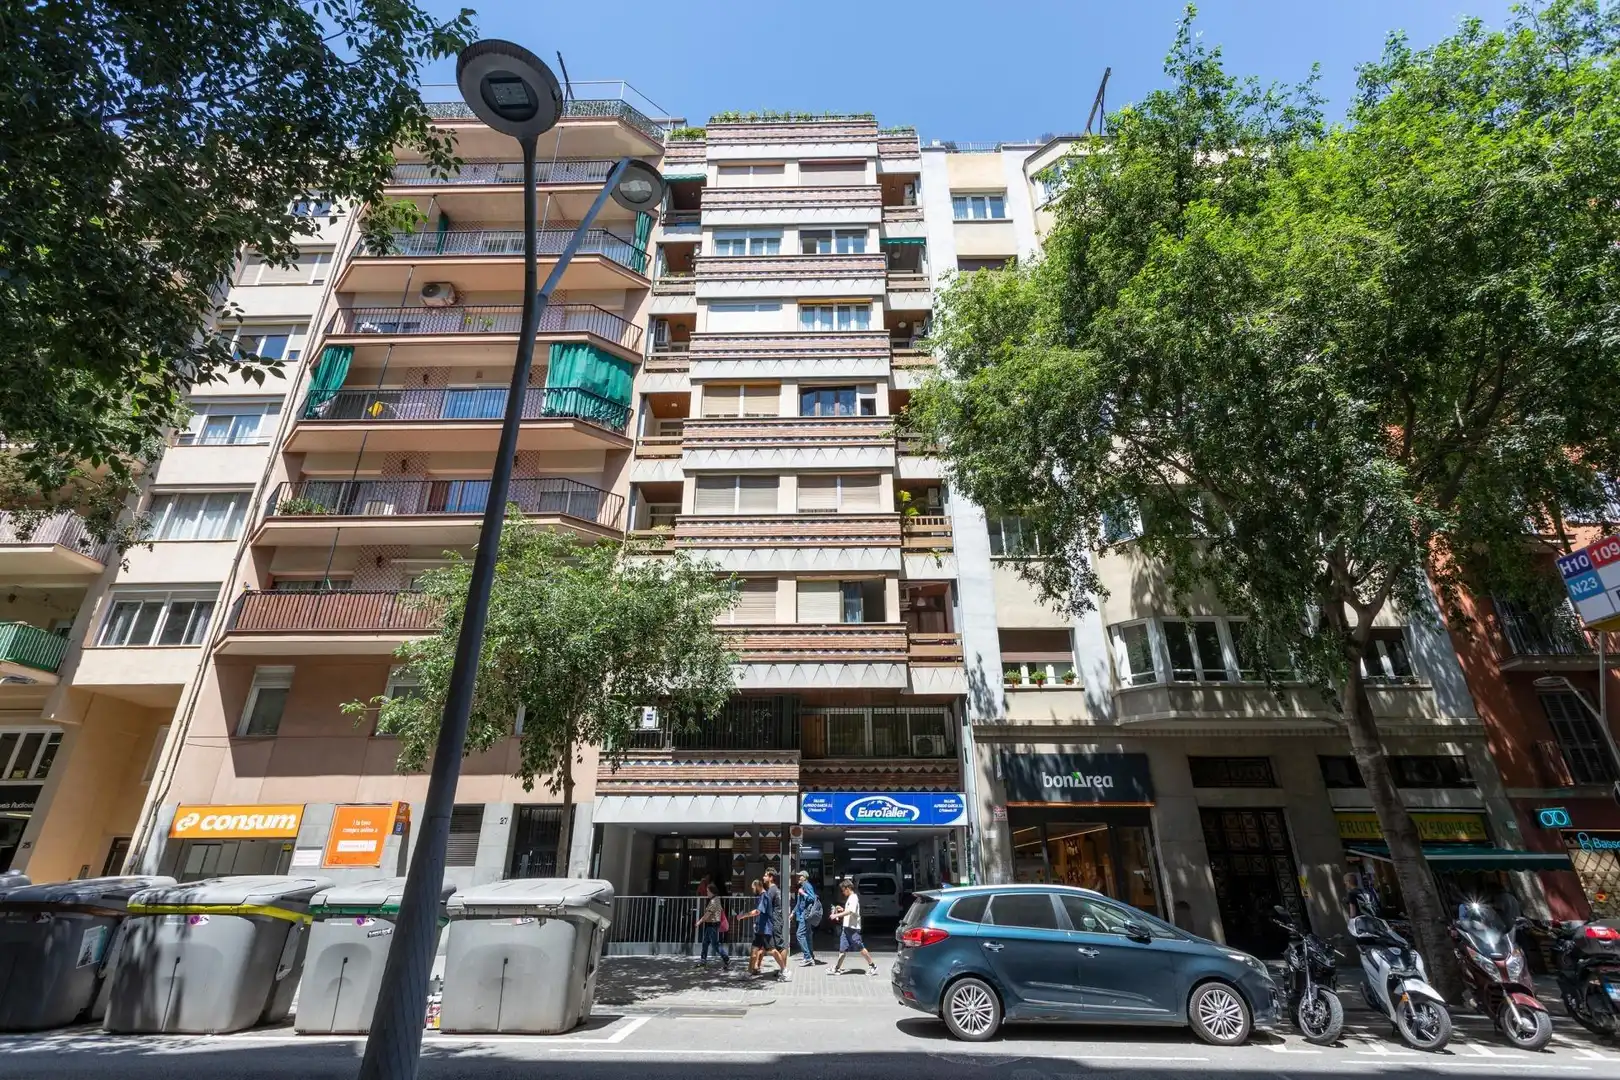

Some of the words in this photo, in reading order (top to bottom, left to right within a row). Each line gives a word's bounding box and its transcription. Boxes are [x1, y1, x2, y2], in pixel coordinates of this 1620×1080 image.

[1592, 542, 1620, 562] 109
[1560, 554, 1589, 575] H10
[1570, 576, 1598, 596] N23
[200, 813, 297, 831] consum
[857, 806, 908, 818] EuroTaller
